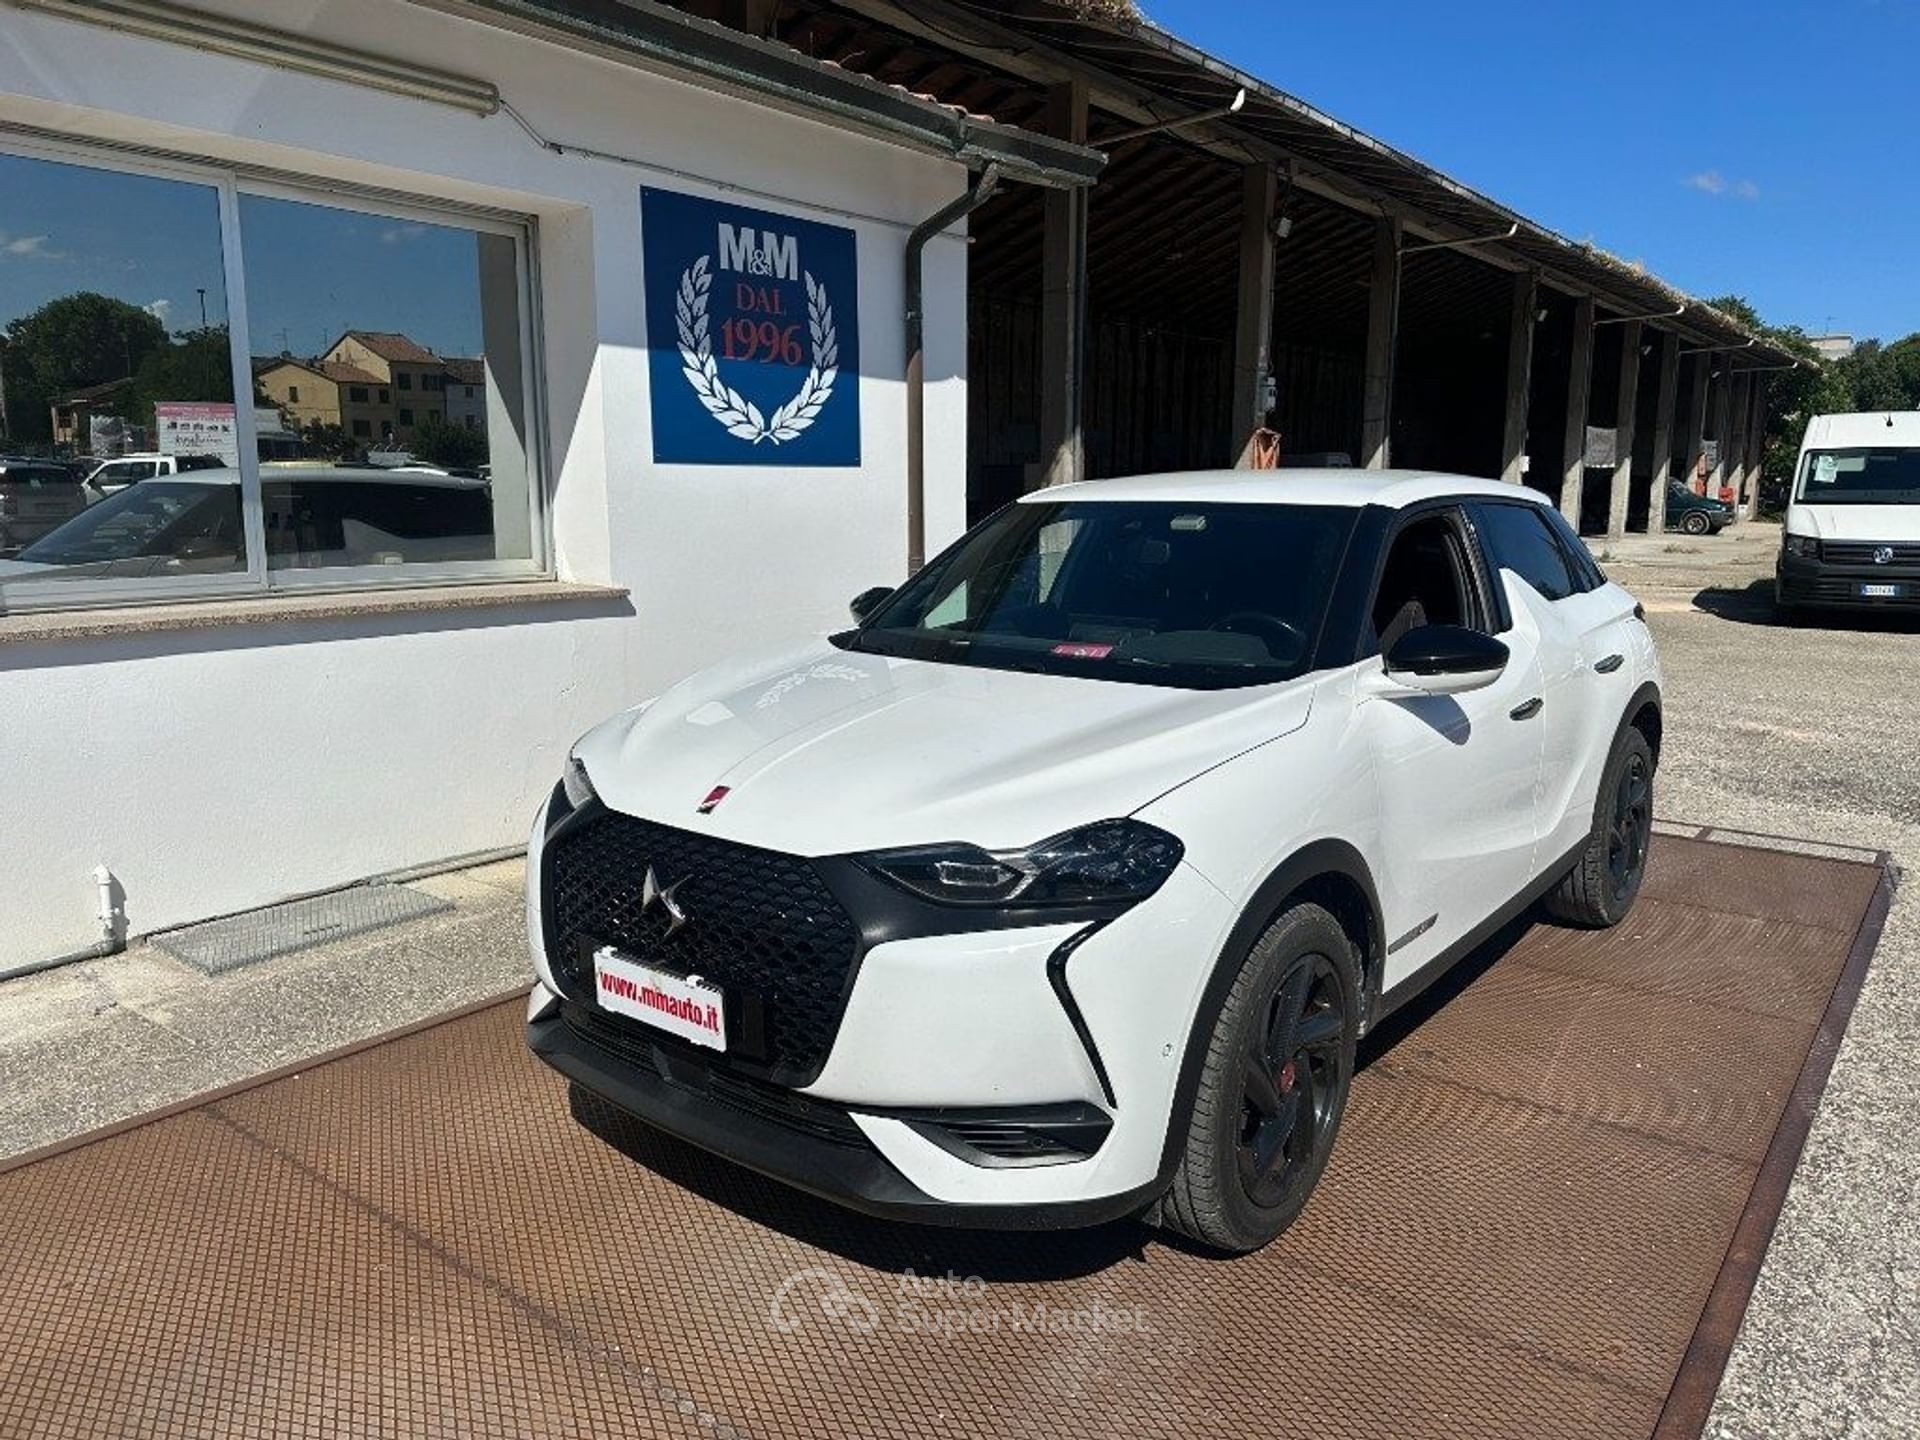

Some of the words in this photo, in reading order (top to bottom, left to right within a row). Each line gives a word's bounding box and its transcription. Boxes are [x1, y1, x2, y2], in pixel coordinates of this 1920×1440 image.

[718, 223, 798, 281] M&M
[736, 283, 786, 315] DAL
[719, 317, 803, 366] 1996
[600, 971, 719, 1032] www.mmauto.it
